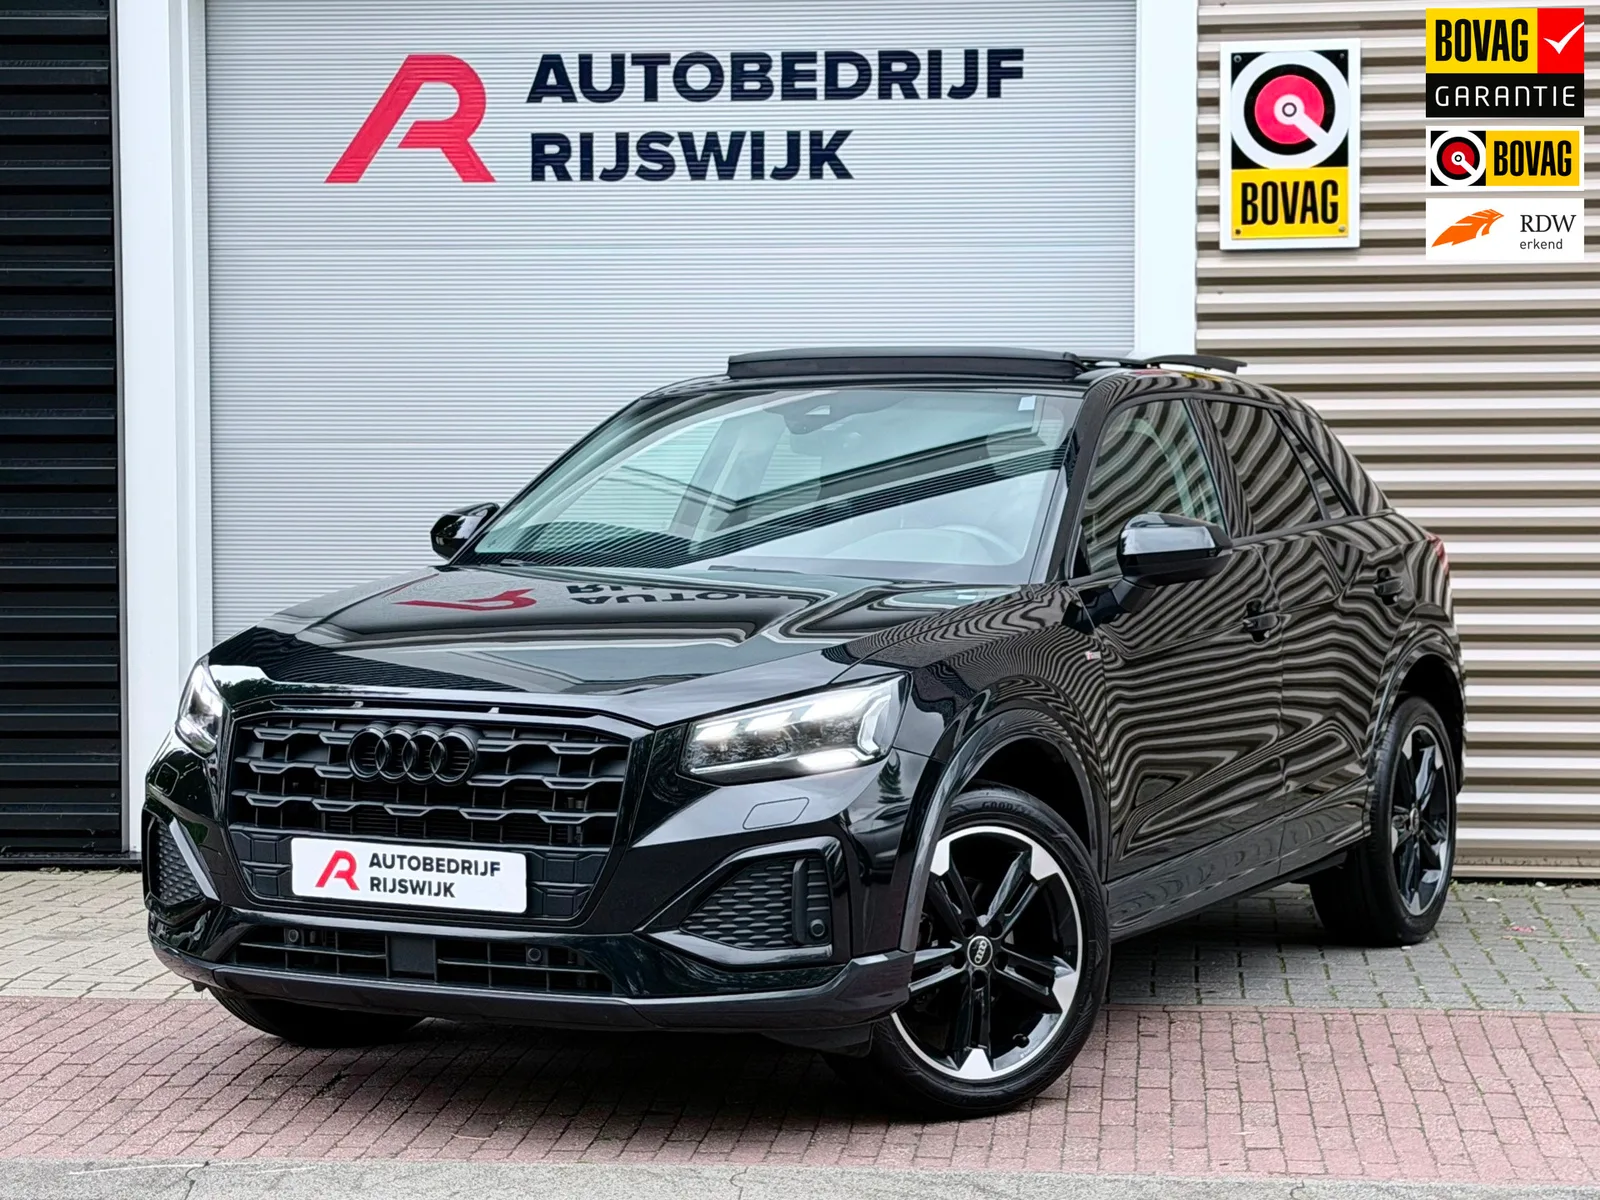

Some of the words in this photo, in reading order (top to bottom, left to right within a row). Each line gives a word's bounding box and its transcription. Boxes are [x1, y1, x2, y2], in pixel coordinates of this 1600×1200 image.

[527, 49, 1024, 103] AUTOBEDRIJF
[530, 130, 854, 182] RIJSWIJK
[1241, 180, 1339, 225] BOVAG
[369, 853, 501, 876] AUTOBEDRIJF
[370, 876, 456, 898] RIJSWIJK
